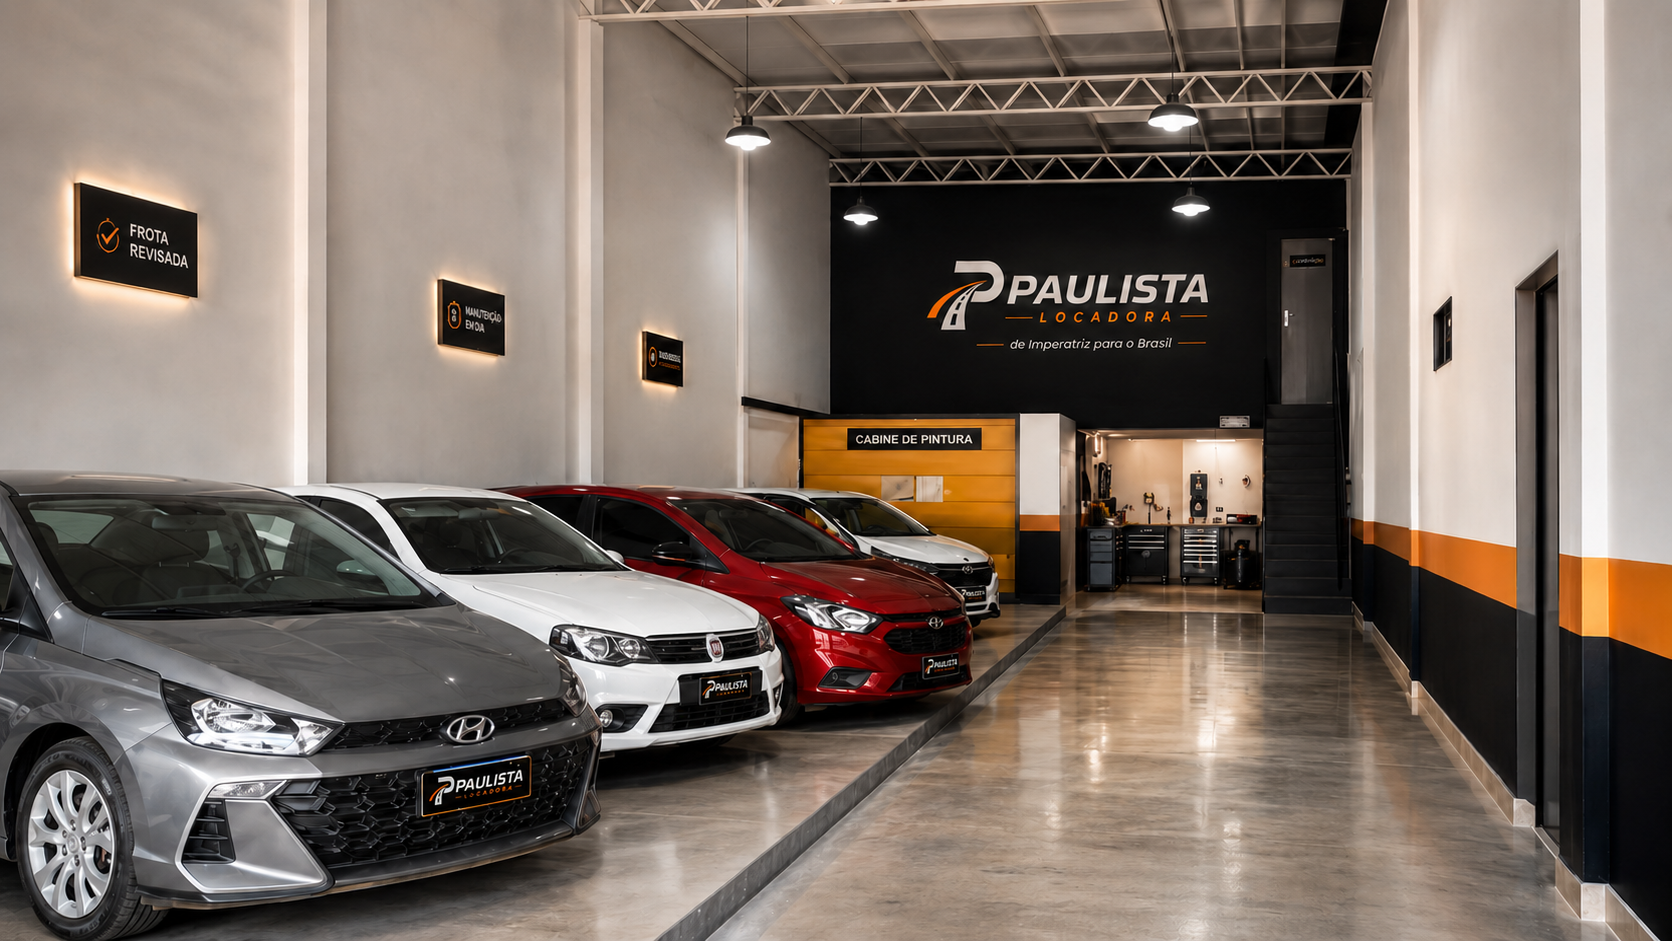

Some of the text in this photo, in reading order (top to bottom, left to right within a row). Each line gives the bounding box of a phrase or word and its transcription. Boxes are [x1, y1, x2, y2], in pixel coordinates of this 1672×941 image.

[130, 223, 169, 246] FROTA
[130, 243, 189, 269] REVISADA
[1006, 273, 1209, 305] PAULISTA
[1039, 311, 1171, 323] LOCADORA
[1010, 338, 1173, 351] de Imperatriz para o Brasil
[855, 434, 973, 445] CABINE DE PINTURA
[715, 679, 748, 692] PAULISTA
[455, 769, 523, 793] PAULISTA
